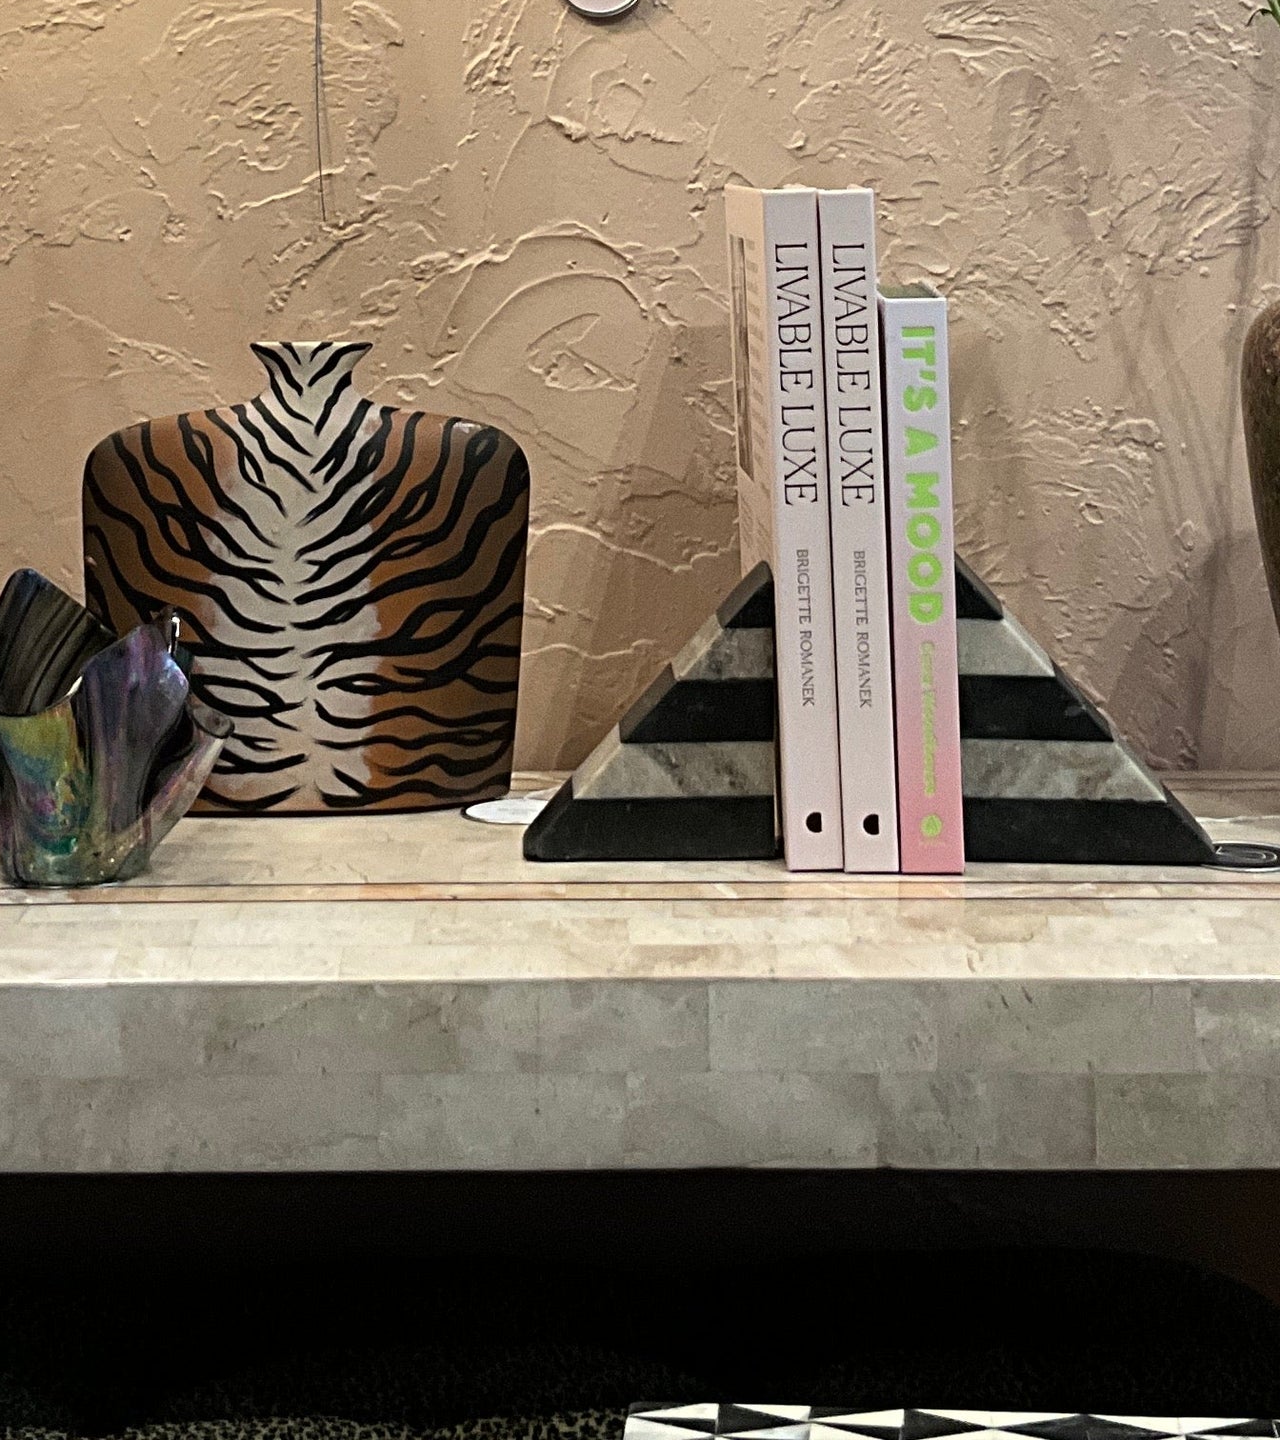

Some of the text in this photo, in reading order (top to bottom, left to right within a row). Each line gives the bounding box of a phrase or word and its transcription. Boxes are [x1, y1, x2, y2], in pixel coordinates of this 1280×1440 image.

[774, 242, 818, 506] LIVABLE LUXE
[831, 242, 875, 507] LIVABLE LUXE
[901, 325, 938, 412] IT'S
[904, 426, 939, 457] A
[796, 548, 815, 706] BRIGETTE ROMANEK
[904, 471, 944, 625] MOOD
[853, 550, 872, 708] BRIGETTE ROMANEK
